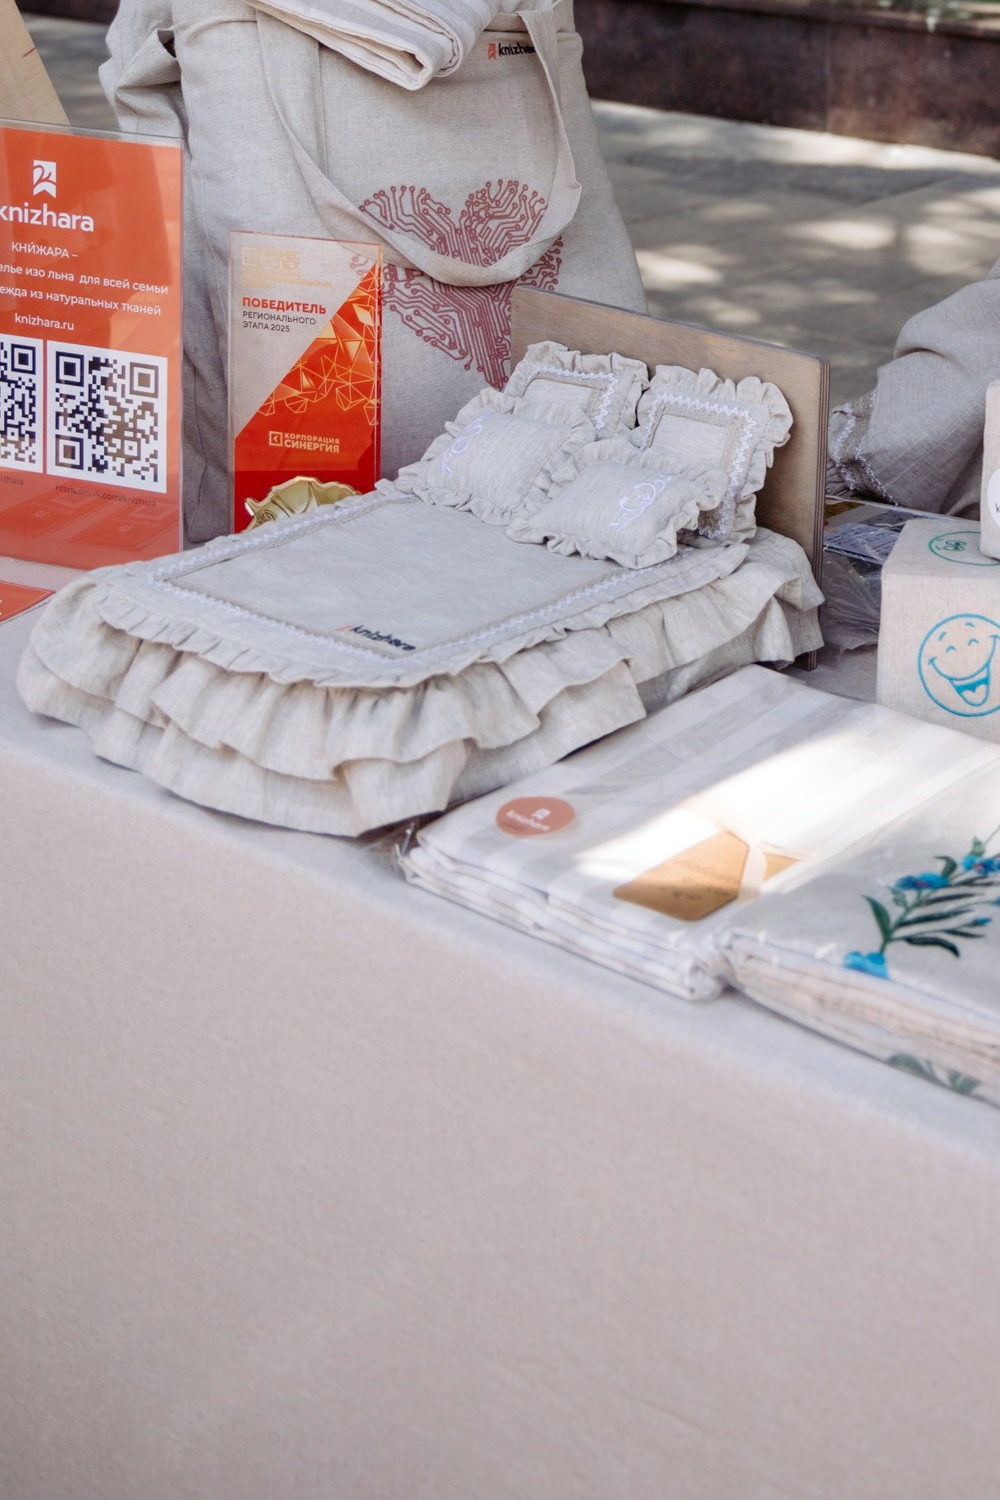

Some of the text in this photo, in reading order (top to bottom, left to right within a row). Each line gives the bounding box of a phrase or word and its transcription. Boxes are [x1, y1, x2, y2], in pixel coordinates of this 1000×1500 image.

[25, 267, 46, 278] изо
[47, 270, 75, 281] льна
[79, 274, 100, 285] для
[103, 278, 130, 289] всей
[132, 282, 169, 294] семьи
[30, 290, 44, 299] из
[46, 291, 119, 310] натуральных
[120, 302, 161, 316] тканей
[242, 297, 327, 315] ПОБЕДИТЕЛЬ
[14, 313, 75, 331] knizhara.ru
[242, 310, 316, 325] РЕГИОНАЛЬНОГО
[242, 320, 291, 333] ЭТАПА 2025
[284, 432, 340, 445] КОРПОРАЦИЯ
[284, 439, 340, 454] СИНЕРГИЯ
